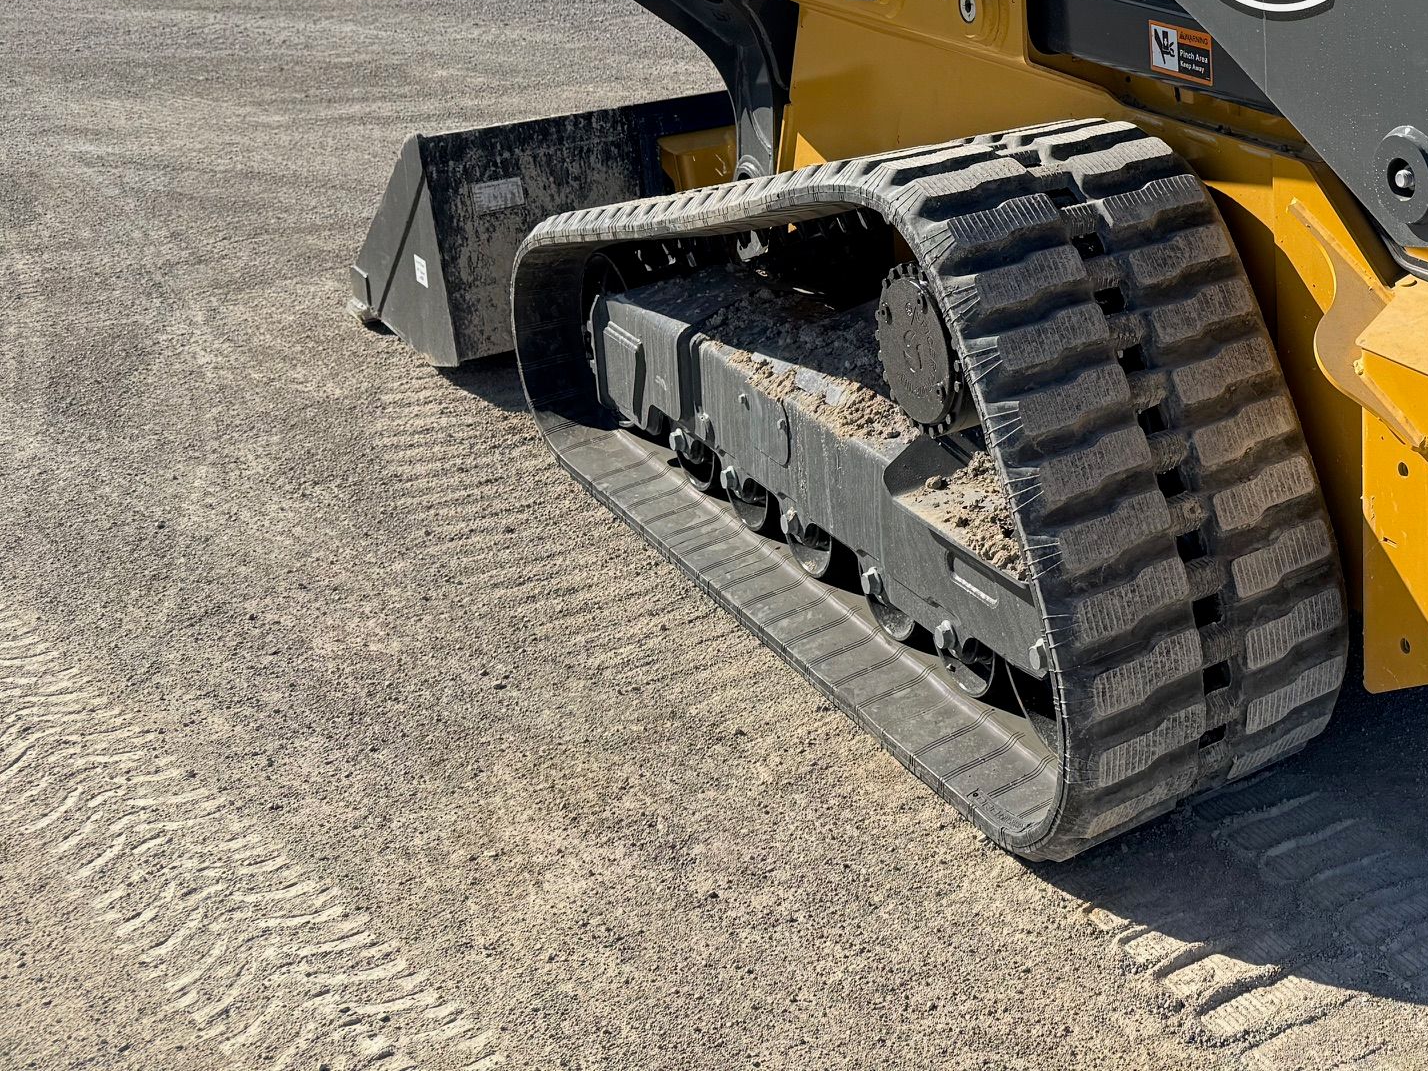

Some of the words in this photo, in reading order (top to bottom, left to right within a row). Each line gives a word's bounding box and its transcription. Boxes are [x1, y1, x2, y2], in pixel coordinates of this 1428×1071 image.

[1185, 33, 1209, 46] WARNING
[1180, 49, 1195, 61] Pinch
[1195, 55, 1208, 64] Area
[1180, 61, 1192, 70] Keep
[1192, 64, 1205, 74] Away
